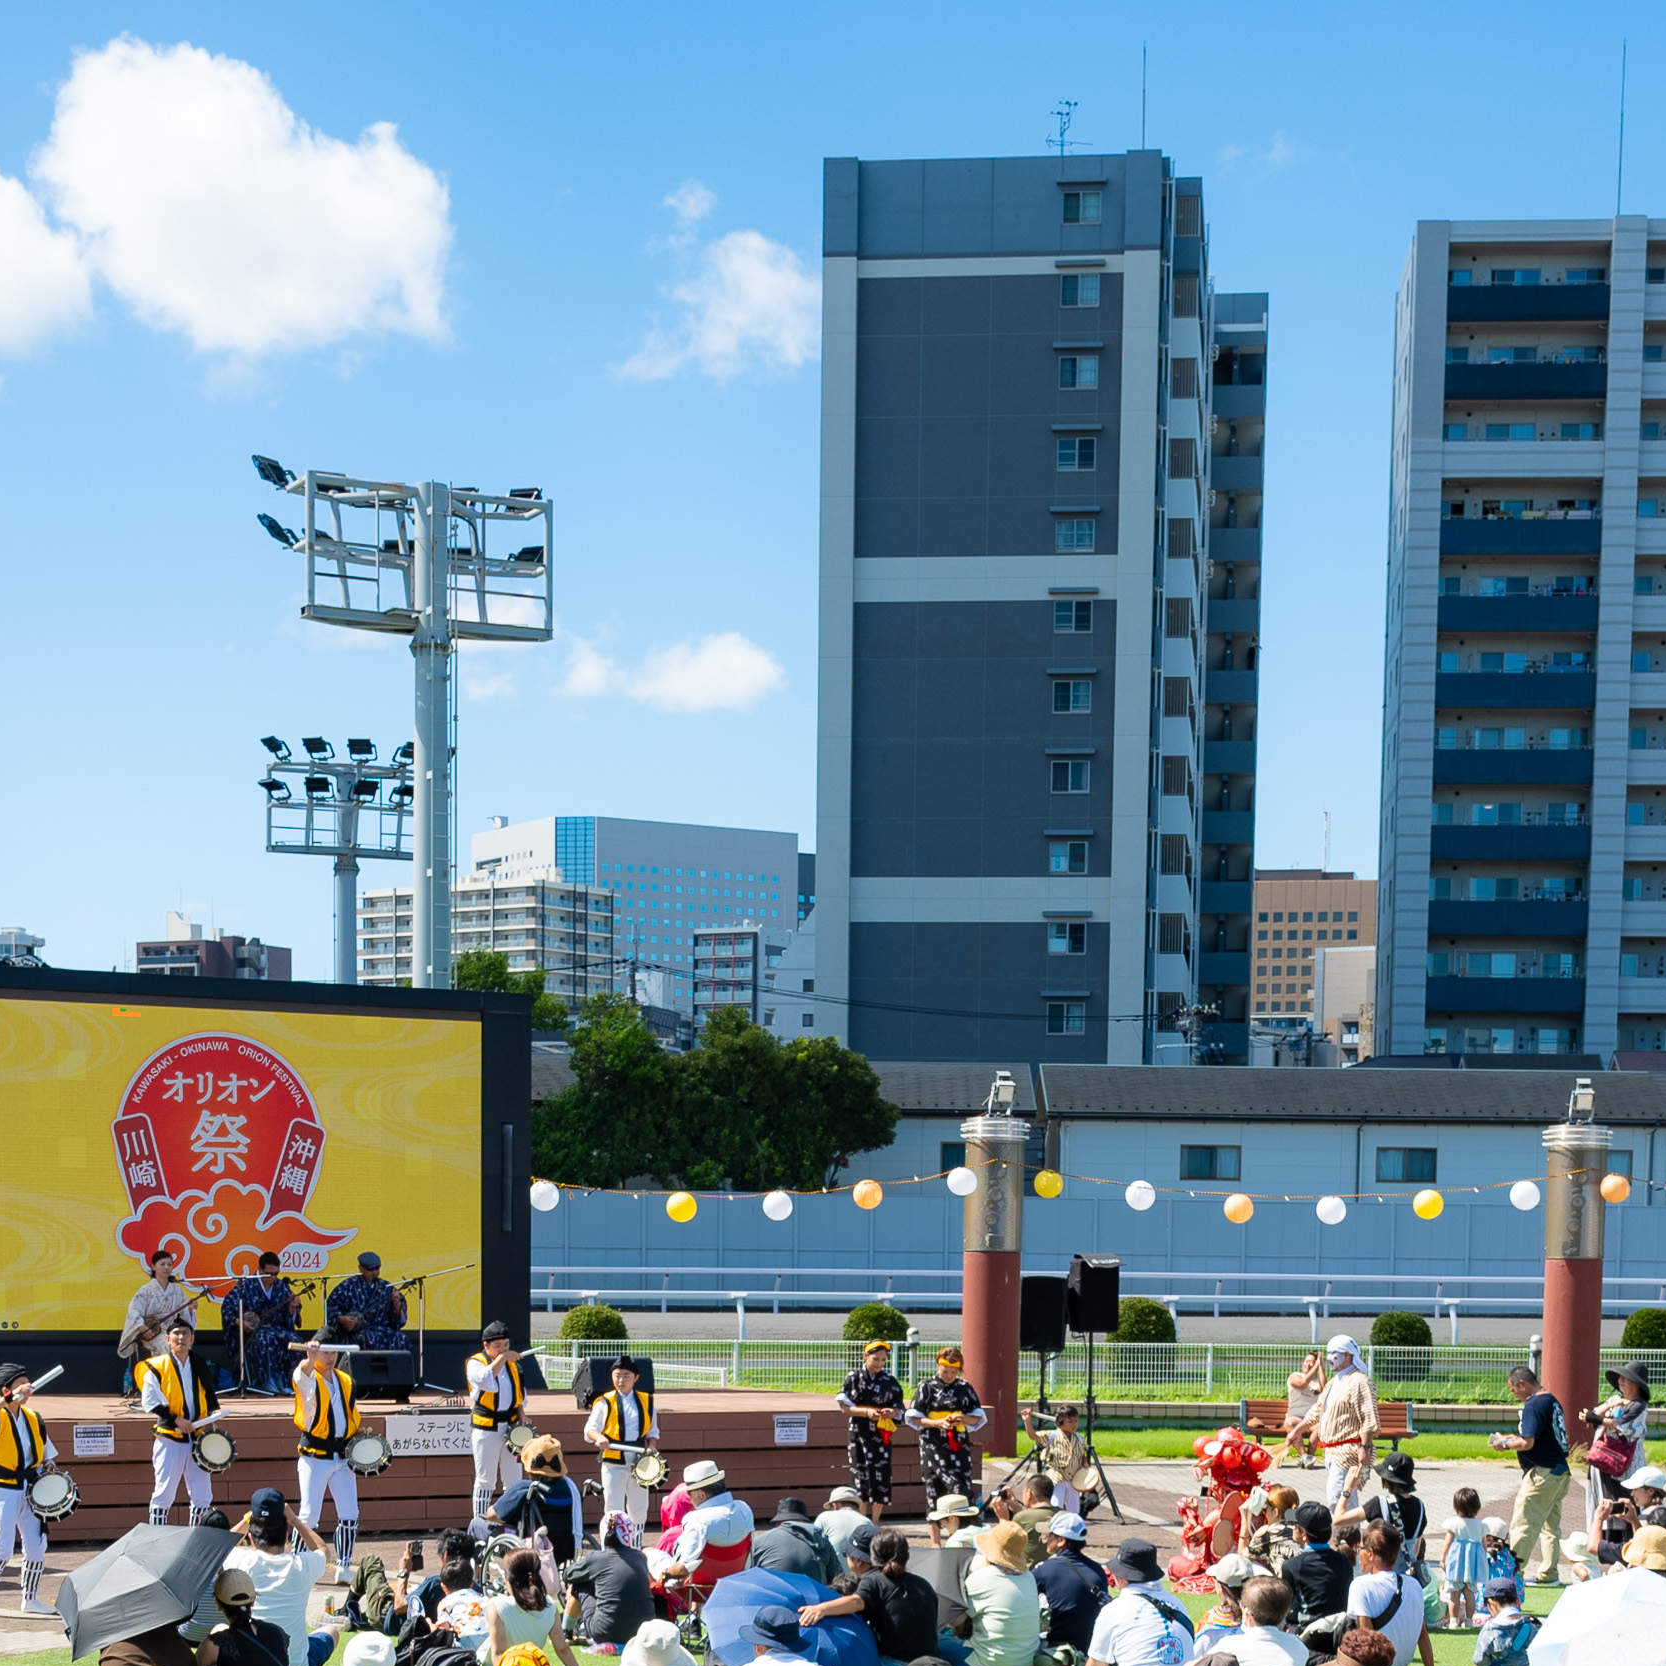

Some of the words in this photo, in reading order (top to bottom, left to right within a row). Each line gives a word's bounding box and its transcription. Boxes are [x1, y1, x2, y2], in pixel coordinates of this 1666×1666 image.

[132, 1055, 173, 1103] KAWASAKI
[180, 1041, 230, 1058] OKINAWA
[238, 1045, 271, 1067] ORION
[270, 1063, 305, 1108] FESTIVAL
[162, 1071, 276, 1105] オリオン
[122, 1129, 157, 1188] 川崎
[190, 1109, 251, 1174] 祭
[279, 1135, 317, 1196] 沖縄
[283, 1251, 322, 1269] 2024
[417, 1421, 465, 1433] ステージに
